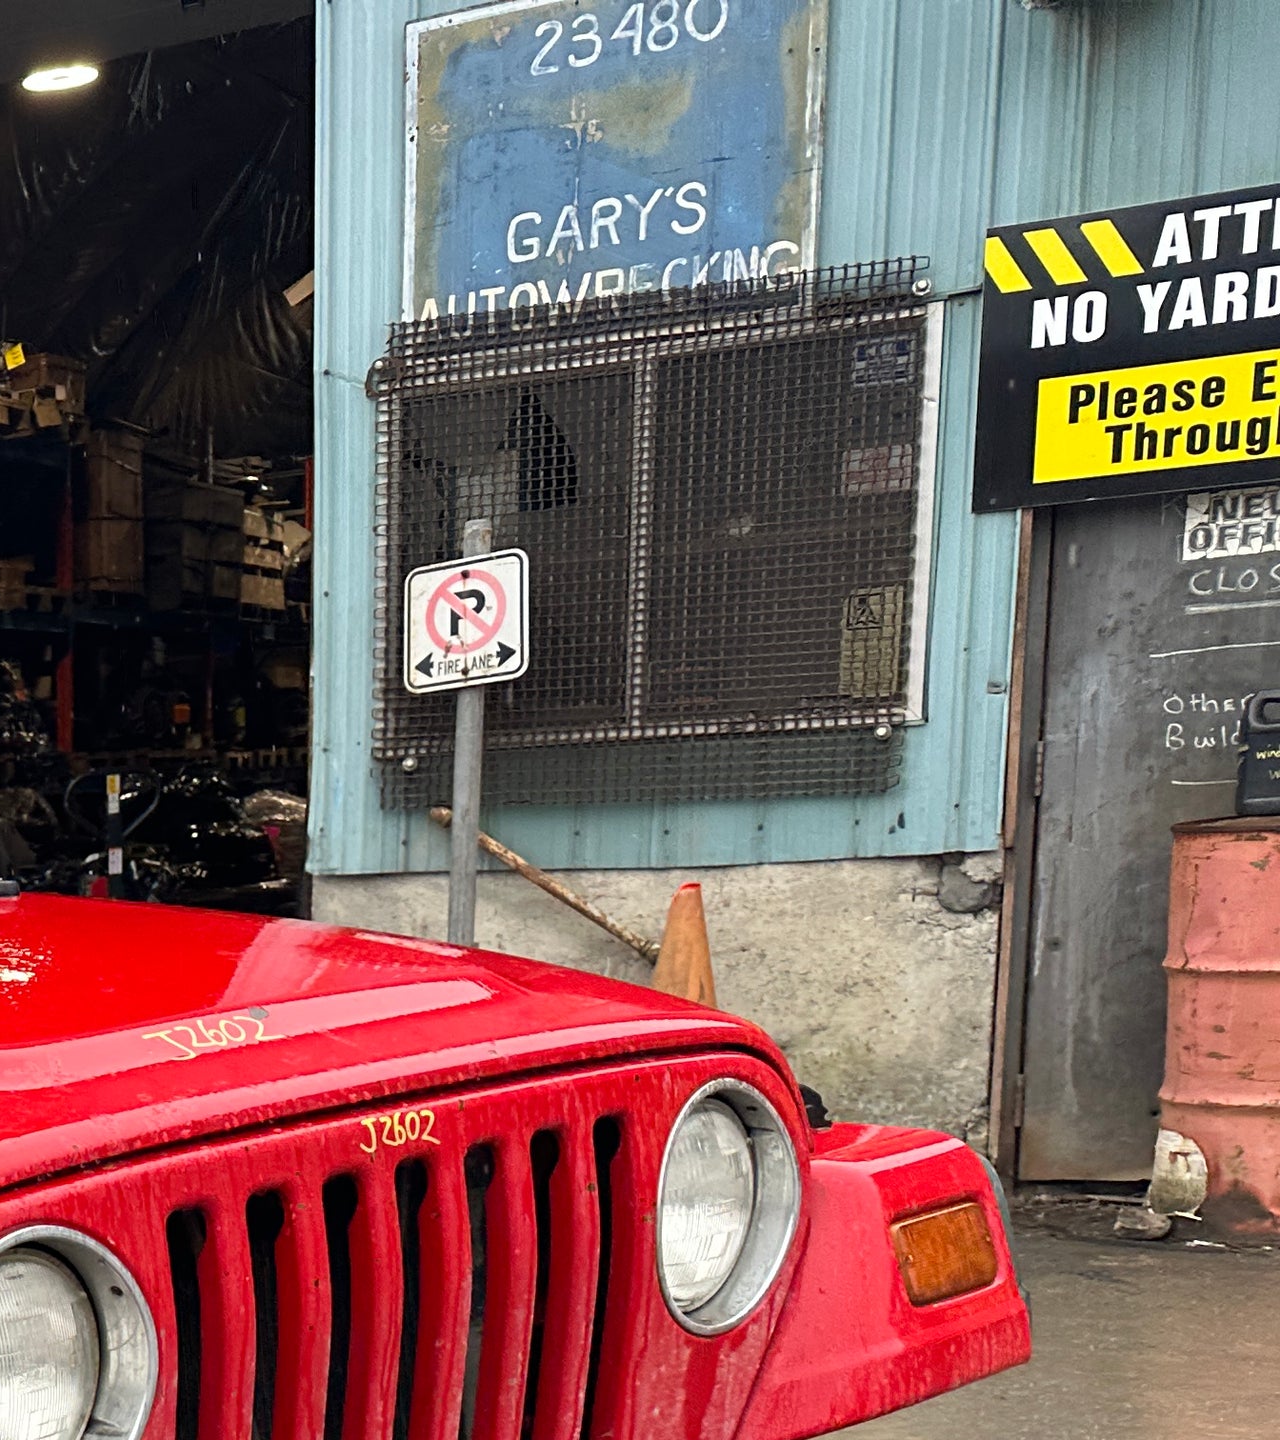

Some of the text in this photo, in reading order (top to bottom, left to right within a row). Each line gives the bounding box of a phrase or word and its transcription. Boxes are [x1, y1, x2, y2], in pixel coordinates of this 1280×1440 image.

[530, 0, 728, 76] 23480
[506, 181, 708, 264] GARY'S
[1031, 290, 1108, 349] NO
[1069, 375, 1226, 424] Please
[142, 1014, 286, 1062] J2602
[360, 1109, 441, 1154] J2602
